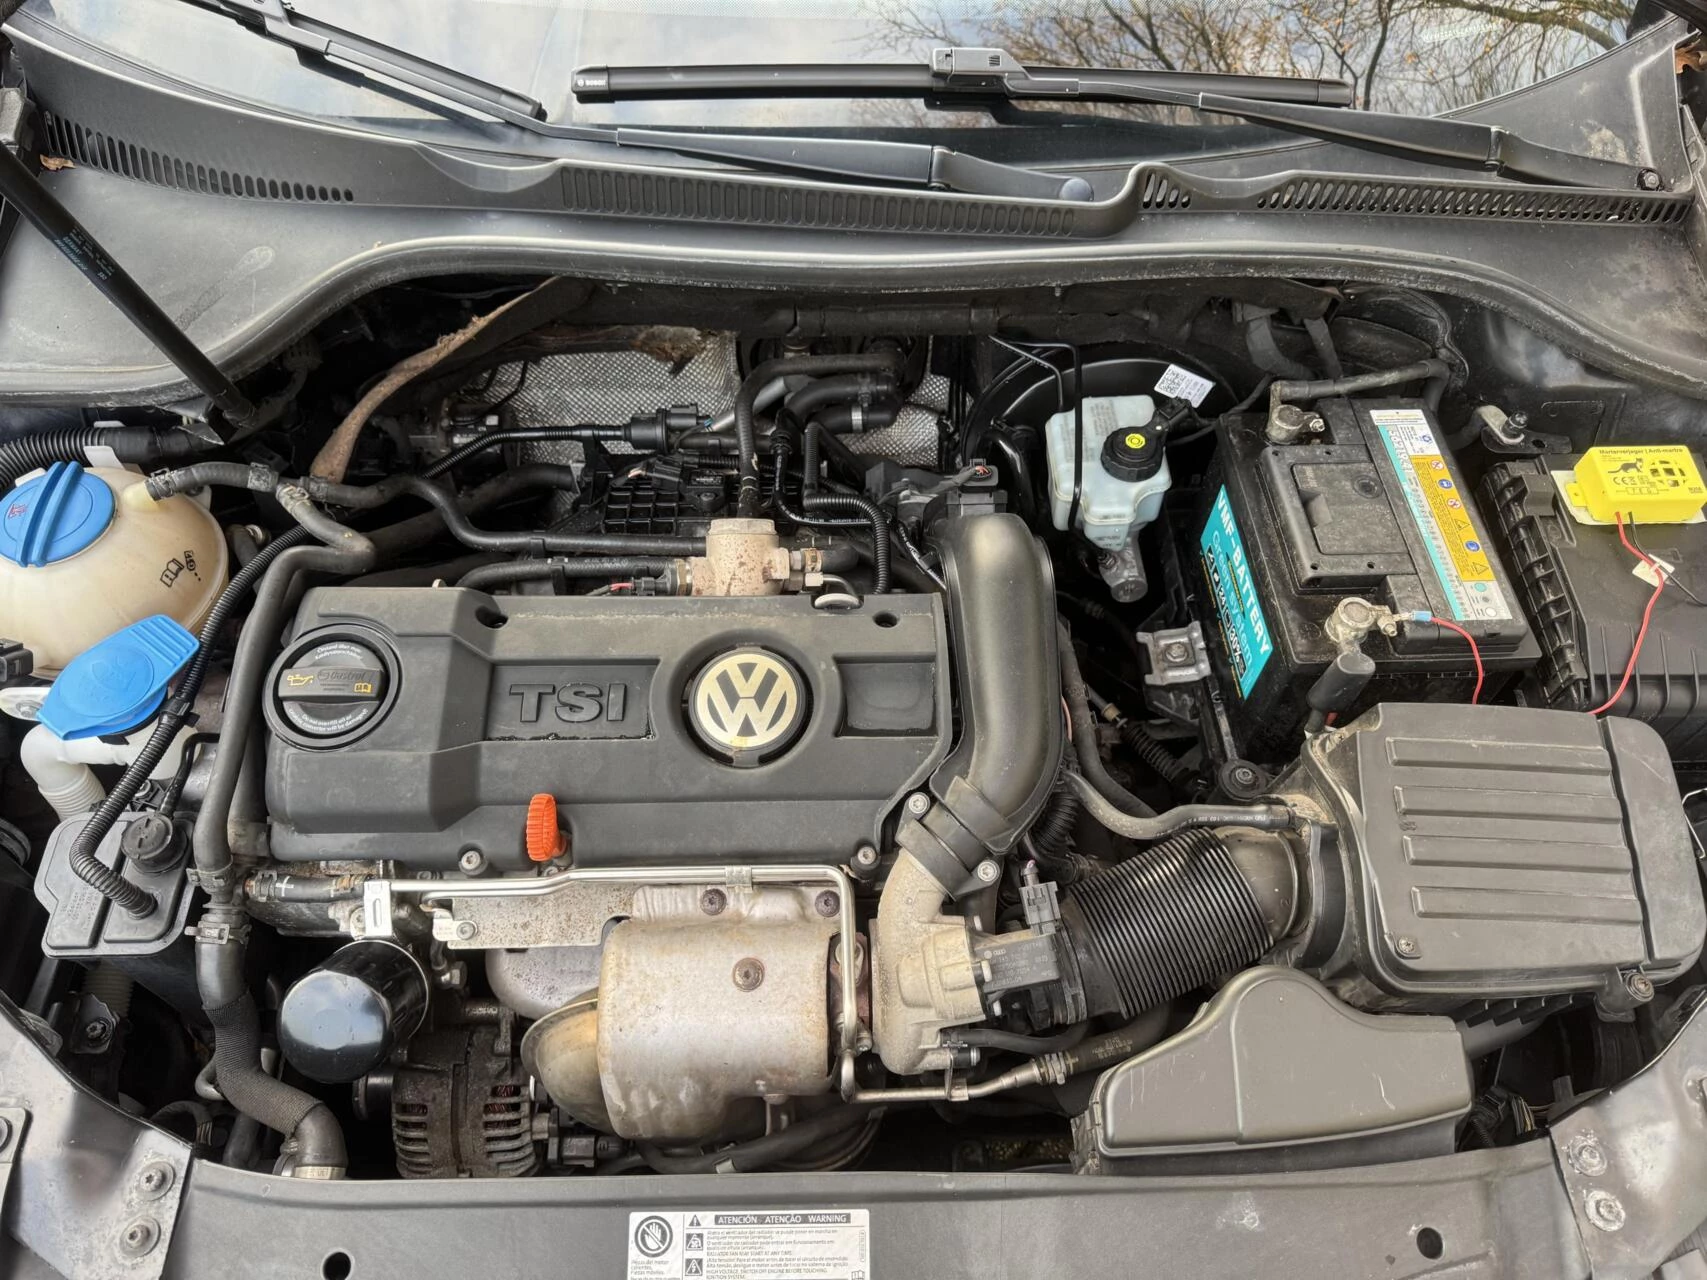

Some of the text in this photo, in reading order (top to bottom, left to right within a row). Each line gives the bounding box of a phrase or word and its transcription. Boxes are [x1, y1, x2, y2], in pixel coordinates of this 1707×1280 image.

[1212, 529, 1231, 590] Green
[1228, 590, 1253, 667] system
[1217, 490, 1270, 655] VMF-BATTERY
[509, 683, 628, 724] TSI
[697, 653, 797, 747] VW
[718, 1214, 847, 1225] ATENCIÓN ATENÇÃO WARNING
